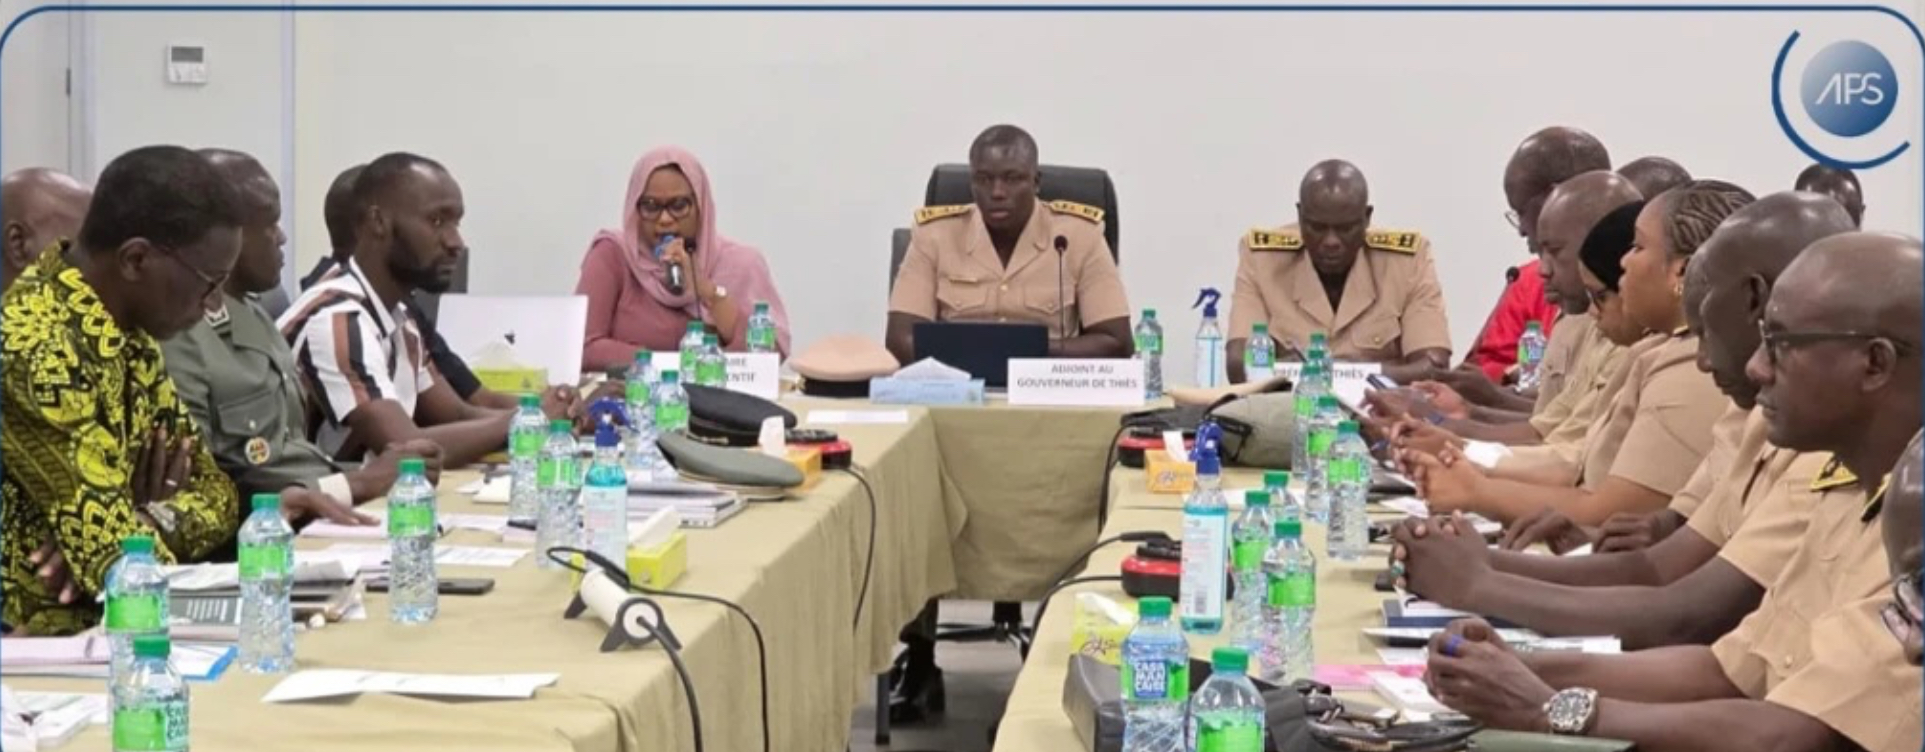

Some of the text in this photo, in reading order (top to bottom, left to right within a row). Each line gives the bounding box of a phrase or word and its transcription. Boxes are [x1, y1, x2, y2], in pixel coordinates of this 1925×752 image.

[1051, 364, 1114, 374] ADJOINT AU
[1335, 366, 1364, 378] THIÈS
[1017, 377, 1138, 389] GOUVERNEUR DE THIÈS
